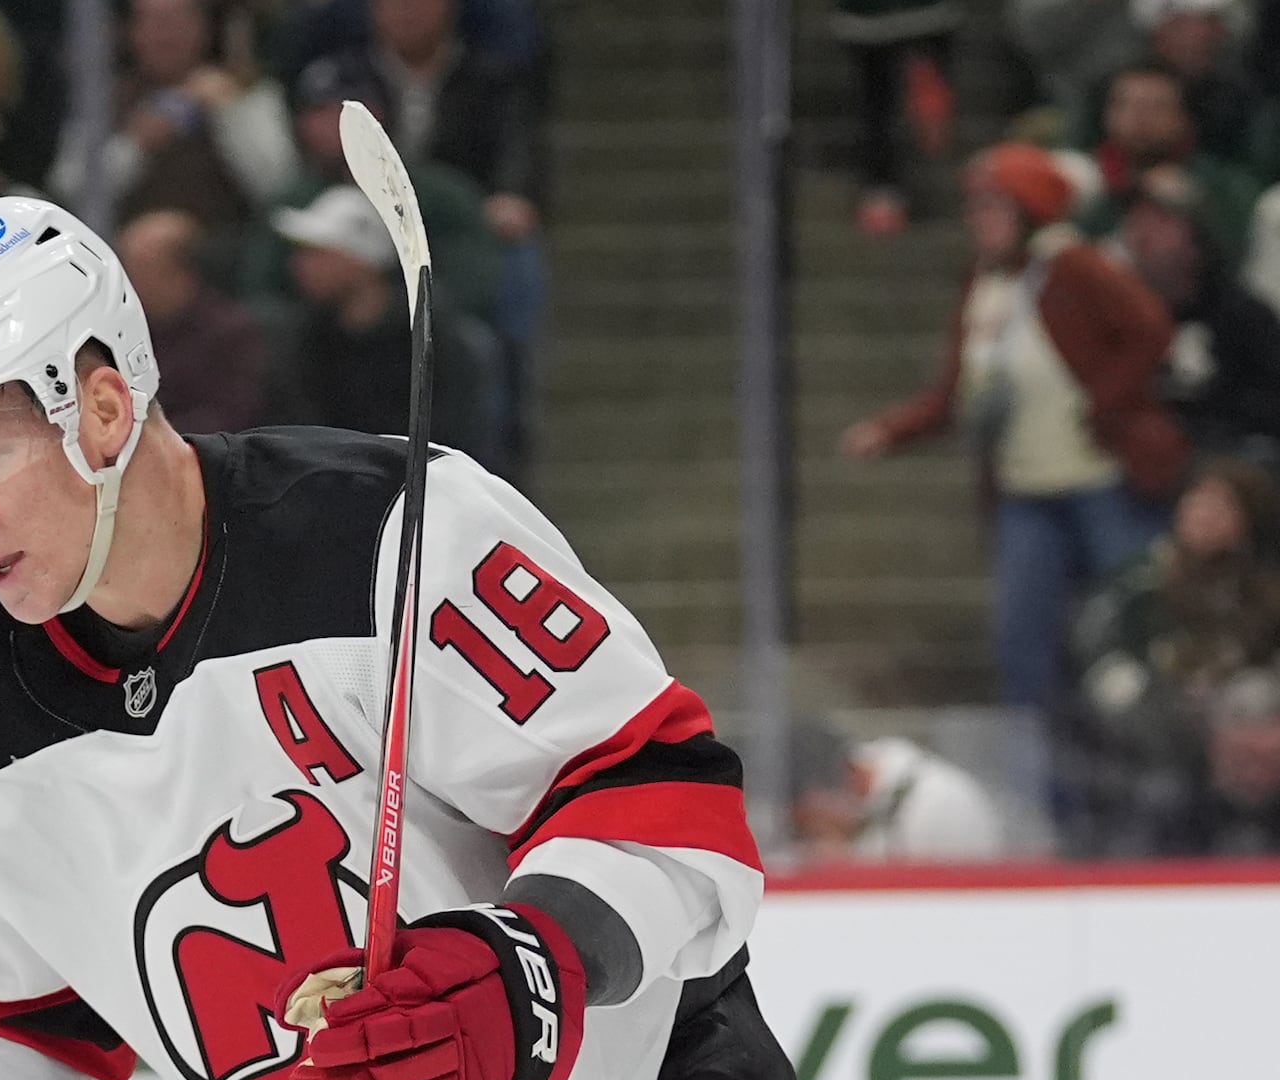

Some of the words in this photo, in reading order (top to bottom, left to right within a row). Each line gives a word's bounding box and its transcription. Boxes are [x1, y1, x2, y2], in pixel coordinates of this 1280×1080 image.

[429, 540, 611, 726] 18
[253, 660, 364, 787] A
[382, 769, 402, 868] BAUER
[462, 903, 559, 1064] UER
